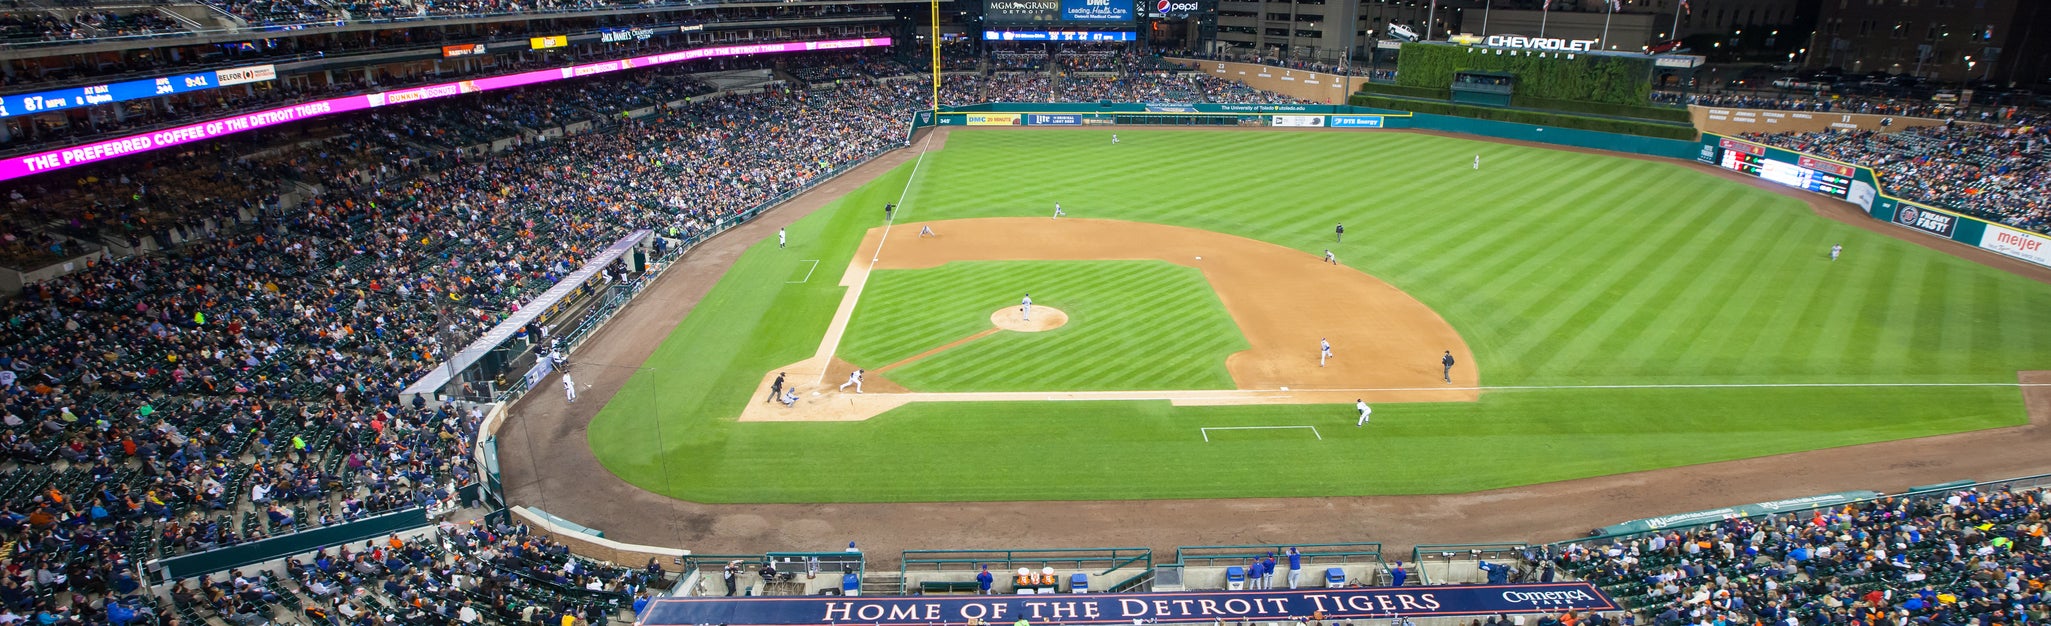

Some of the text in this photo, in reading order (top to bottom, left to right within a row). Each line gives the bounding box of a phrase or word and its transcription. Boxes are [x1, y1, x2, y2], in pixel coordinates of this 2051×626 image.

[1172, 2, 1198, 11] pepsi
[716, 47, 729, 55] THE
[730, 45, 759, 54] DETROIT
[761, 44, 784, 52] TIGERS
[1488, 36, 1594, 51] CHEVROLET
[1468, 48, 1574, 59] FOUNTAIN
[185, 76, 208, 87] 9:41
[218, 73, 242, 82] BELFOR
[94, 85, 108, 94] BAT
[24, 96, 43, 111] 87
[45, 98, 66, 108] MPH
[1036, 115, 1050, 124] Lite
[24, 102, 331, 171] THE PREFERRED COFFEE OF THE DETROIT TIGERS
[1920, 211, 1951, 224] FREAKY
[1916, 217, 1949, 233] FAST!
[1997, 232, 2042, 251] meijer
[1503, 589, 1595, 603] Comerica
[822, 593, 1440, 621] HOME OF THE DETROIT TIGERS
